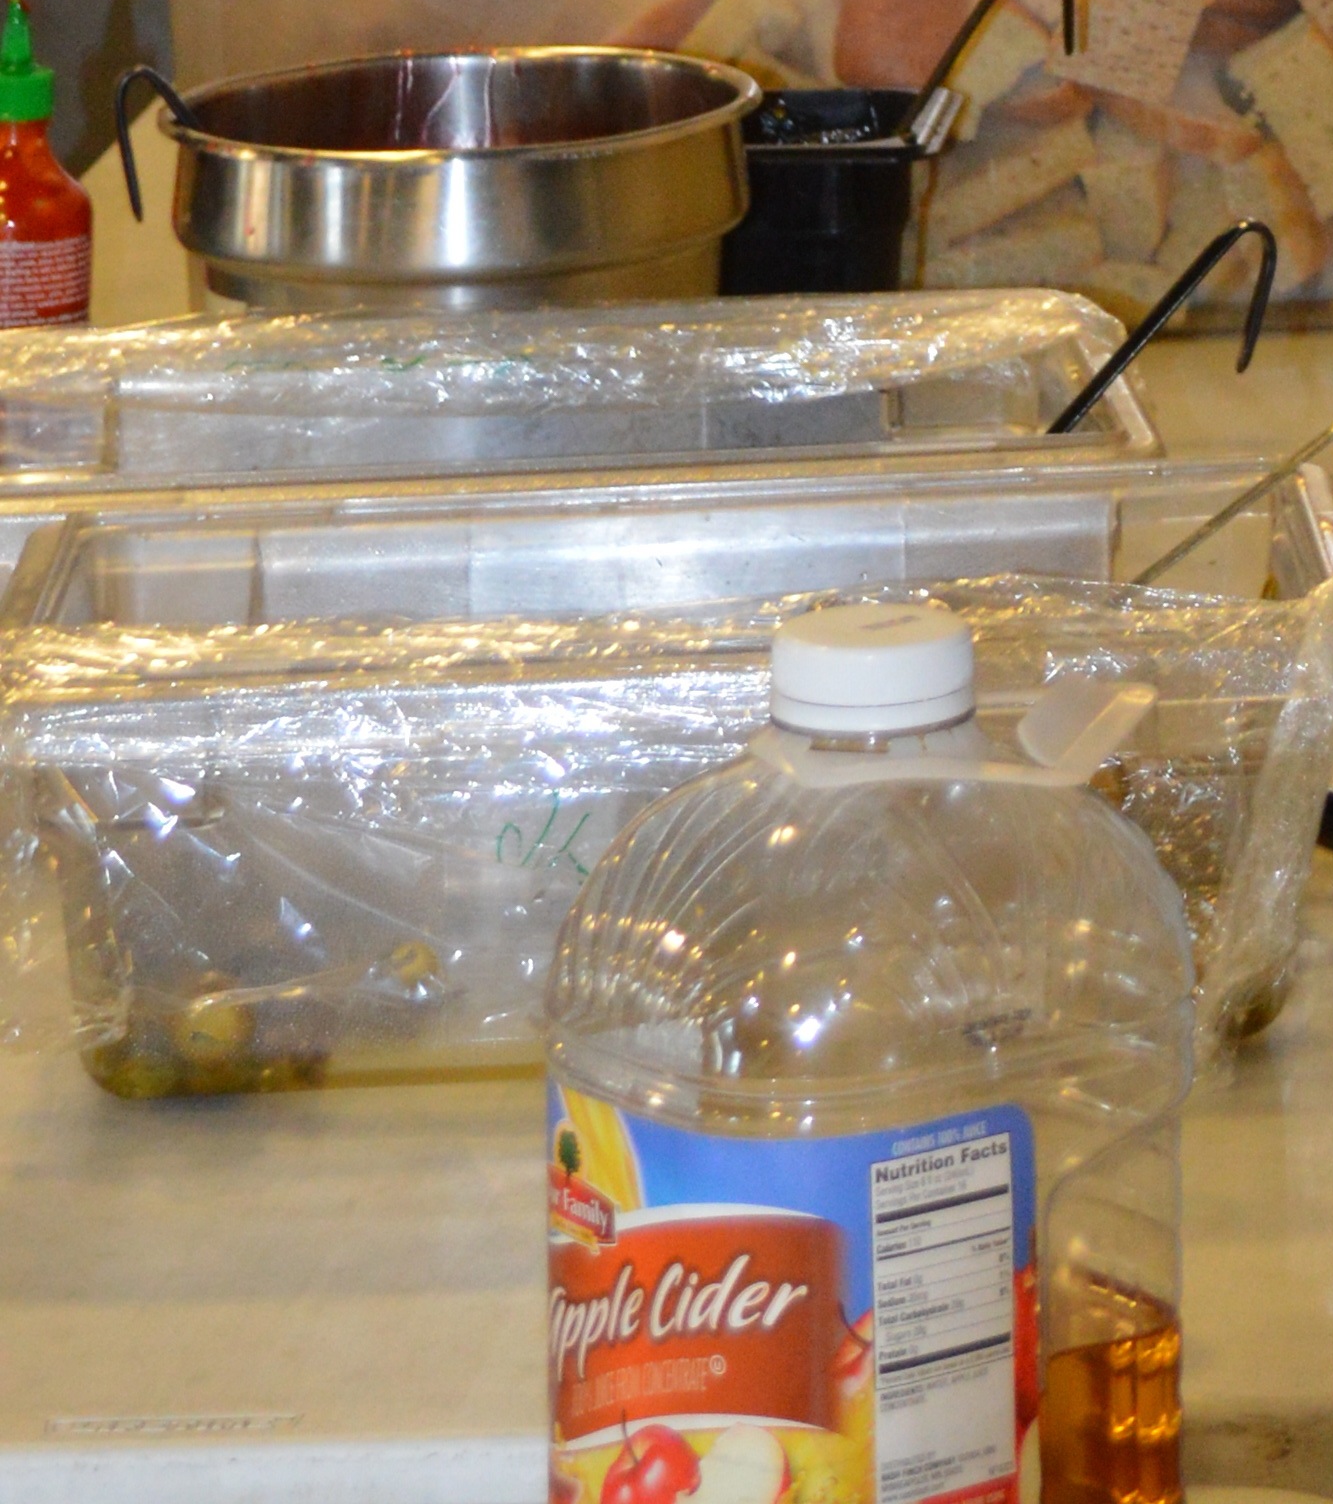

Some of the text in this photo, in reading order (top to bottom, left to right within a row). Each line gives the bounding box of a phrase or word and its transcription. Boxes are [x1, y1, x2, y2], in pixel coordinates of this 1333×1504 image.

[875, 1153, 955, 1183] Nutrition
[960, 1140, 1008, 1165] Facts
[563, 1187, 611, 1235] Family
[649, 1253, 809, 1339] Cider
